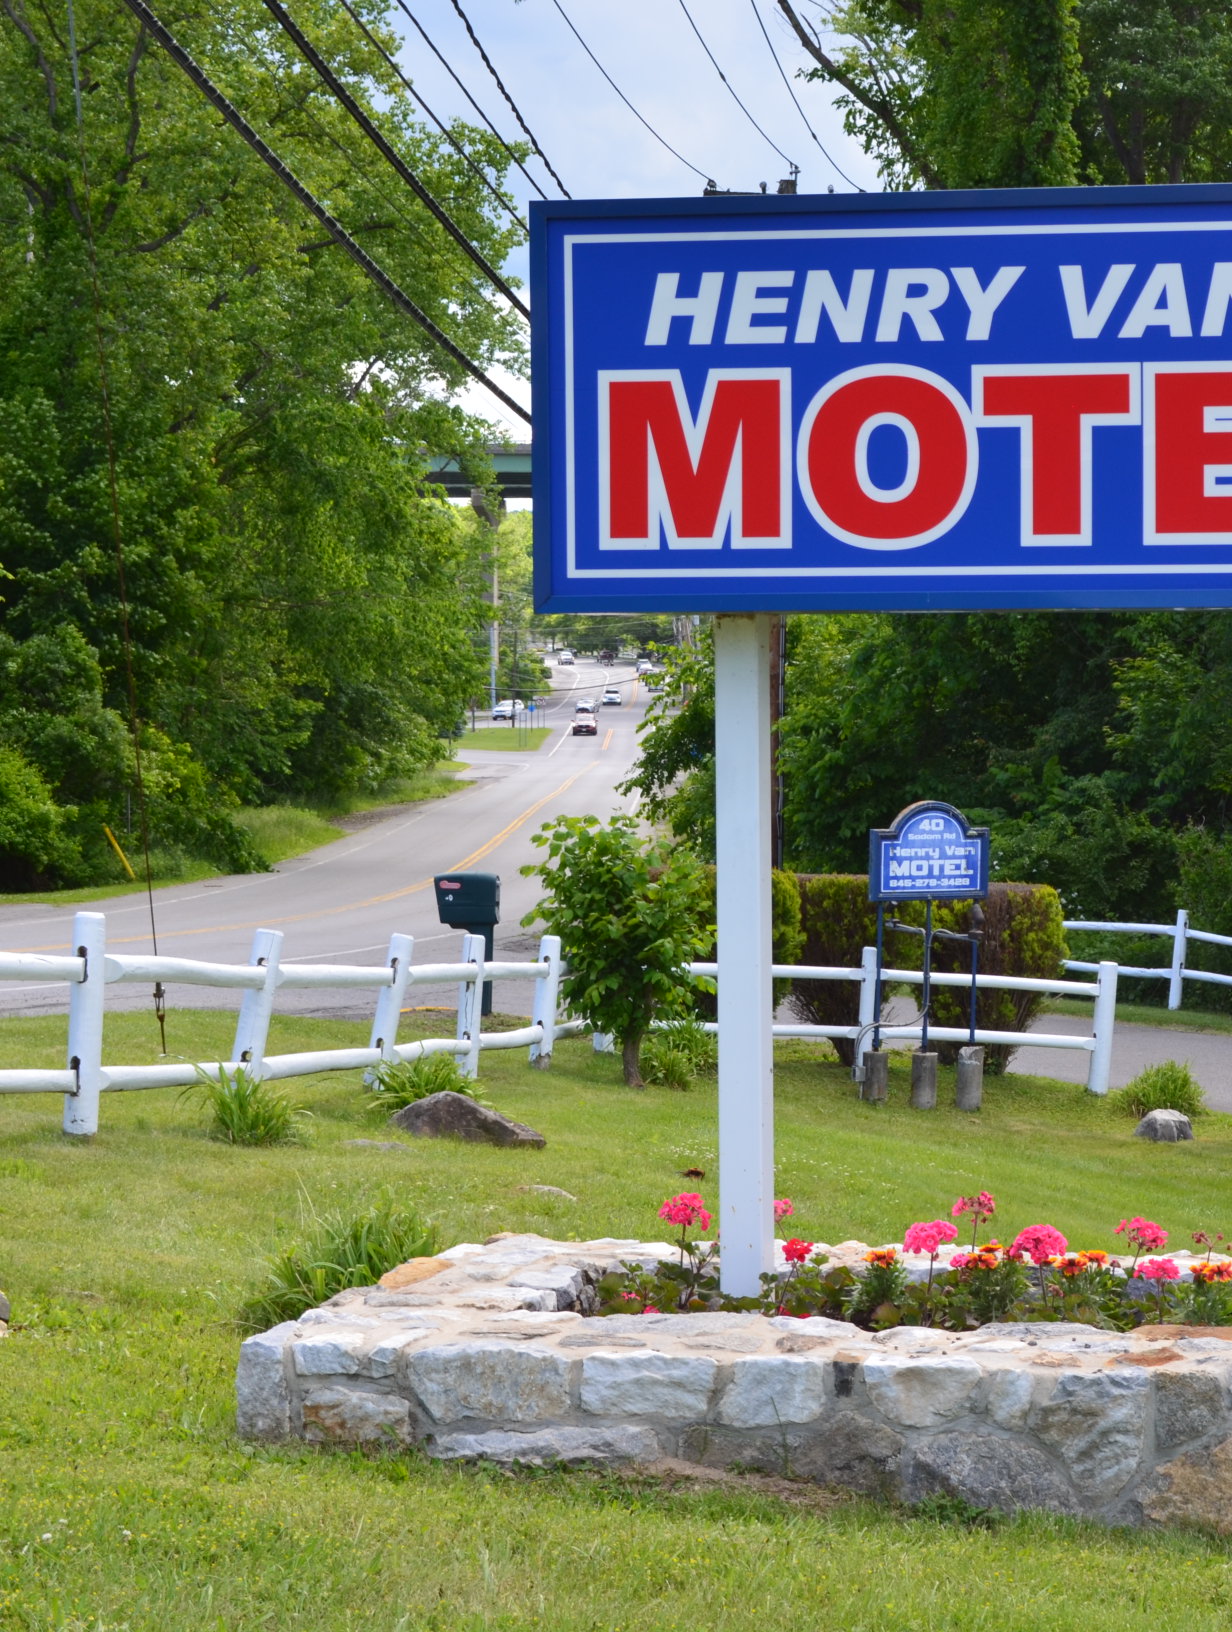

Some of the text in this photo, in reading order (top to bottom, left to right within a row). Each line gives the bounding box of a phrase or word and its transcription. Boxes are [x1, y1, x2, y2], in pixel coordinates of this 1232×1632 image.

[645, 265, 1026, 346] HENRY
[919, 818, 944, 831] 40
[943, 832, 956, 840] Rd
[889, 845, 975, 859] Henry Van
[889, 859, 974, 877] MOTEL
